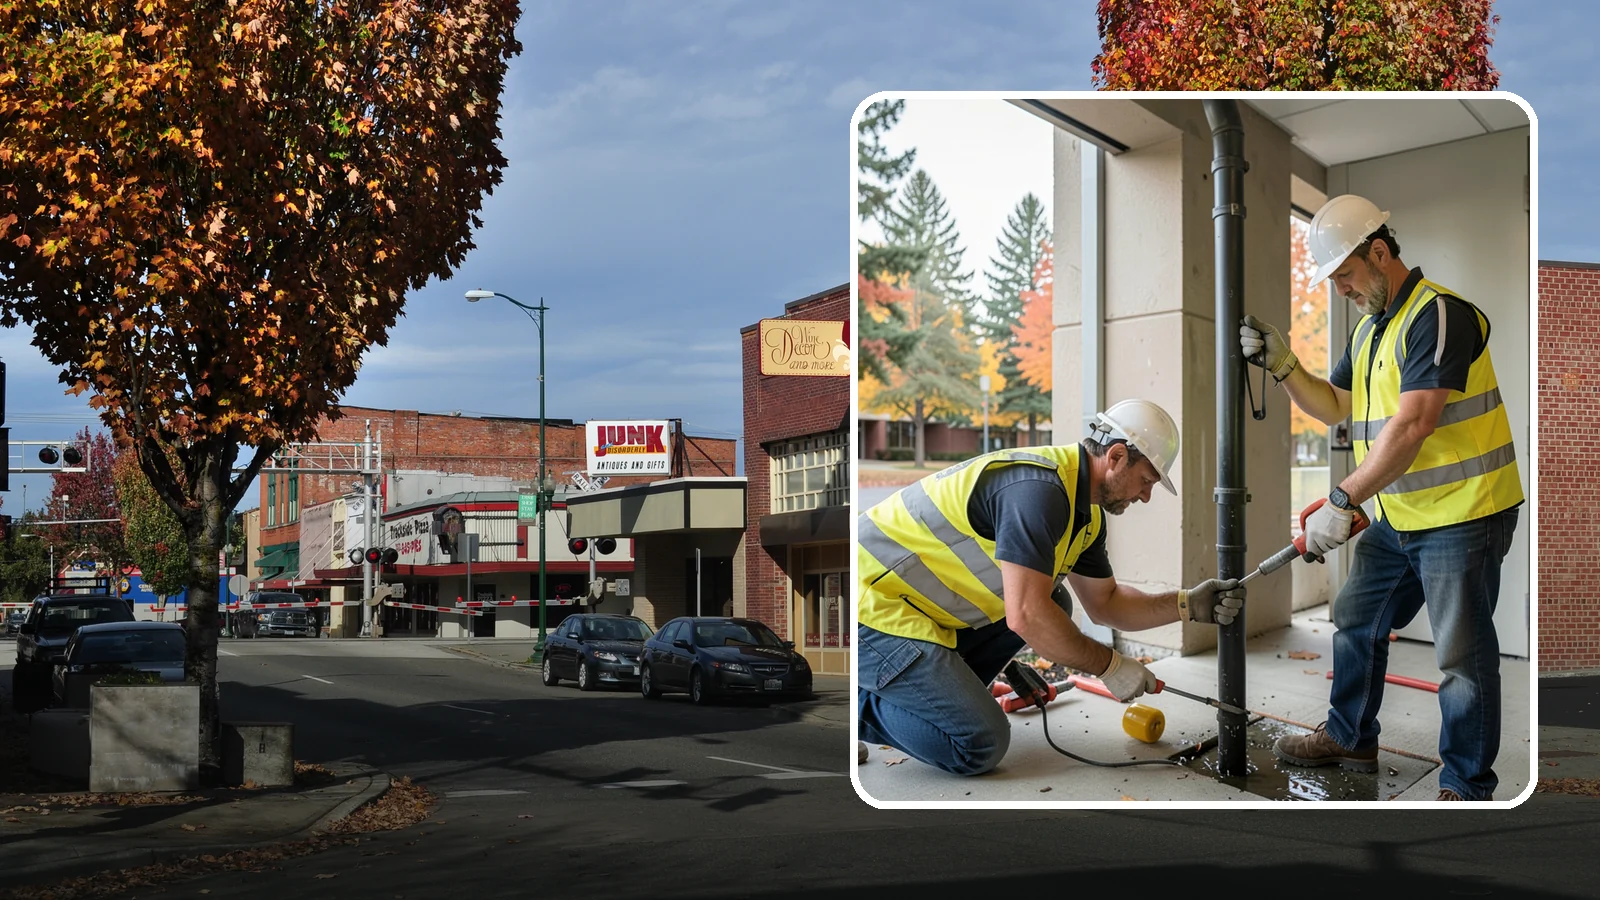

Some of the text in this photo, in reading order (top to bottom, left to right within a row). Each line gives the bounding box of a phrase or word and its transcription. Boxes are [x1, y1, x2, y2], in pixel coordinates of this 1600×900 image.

[595, 425, 666, 457] JUNK
[607, 446, 646, 454] DISORDERLY
[597, 460, 665, 470] ANTIQUES AND GIFTS
[390, 519, 429, 539] Trackside Pizza
